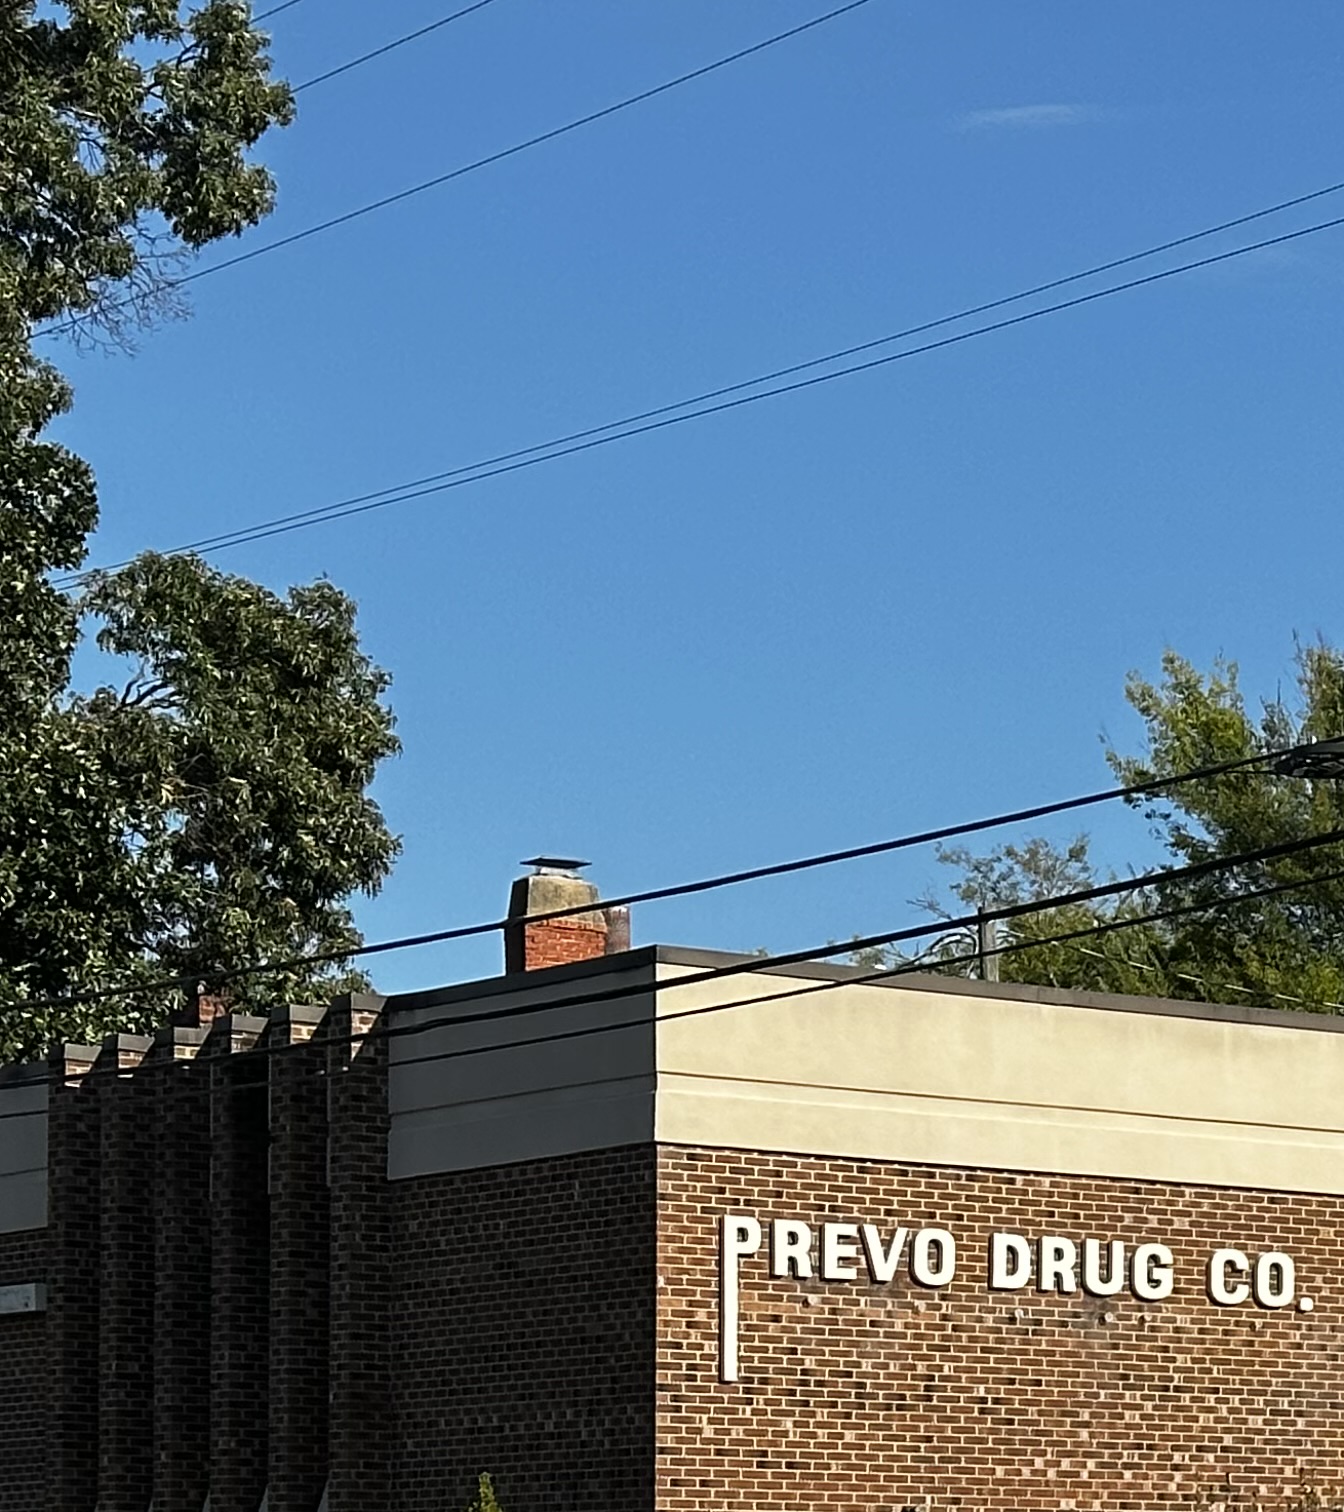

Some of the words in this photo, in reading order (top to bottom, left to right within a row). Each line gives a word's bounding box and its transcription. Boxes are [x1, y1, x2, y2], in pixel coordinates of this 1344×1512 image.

[719, 1214, 957, 1382] PREVO
[989, 1231, 1175, 1301] DRUG
[1207, 1247, 1314, 1313] CO.
